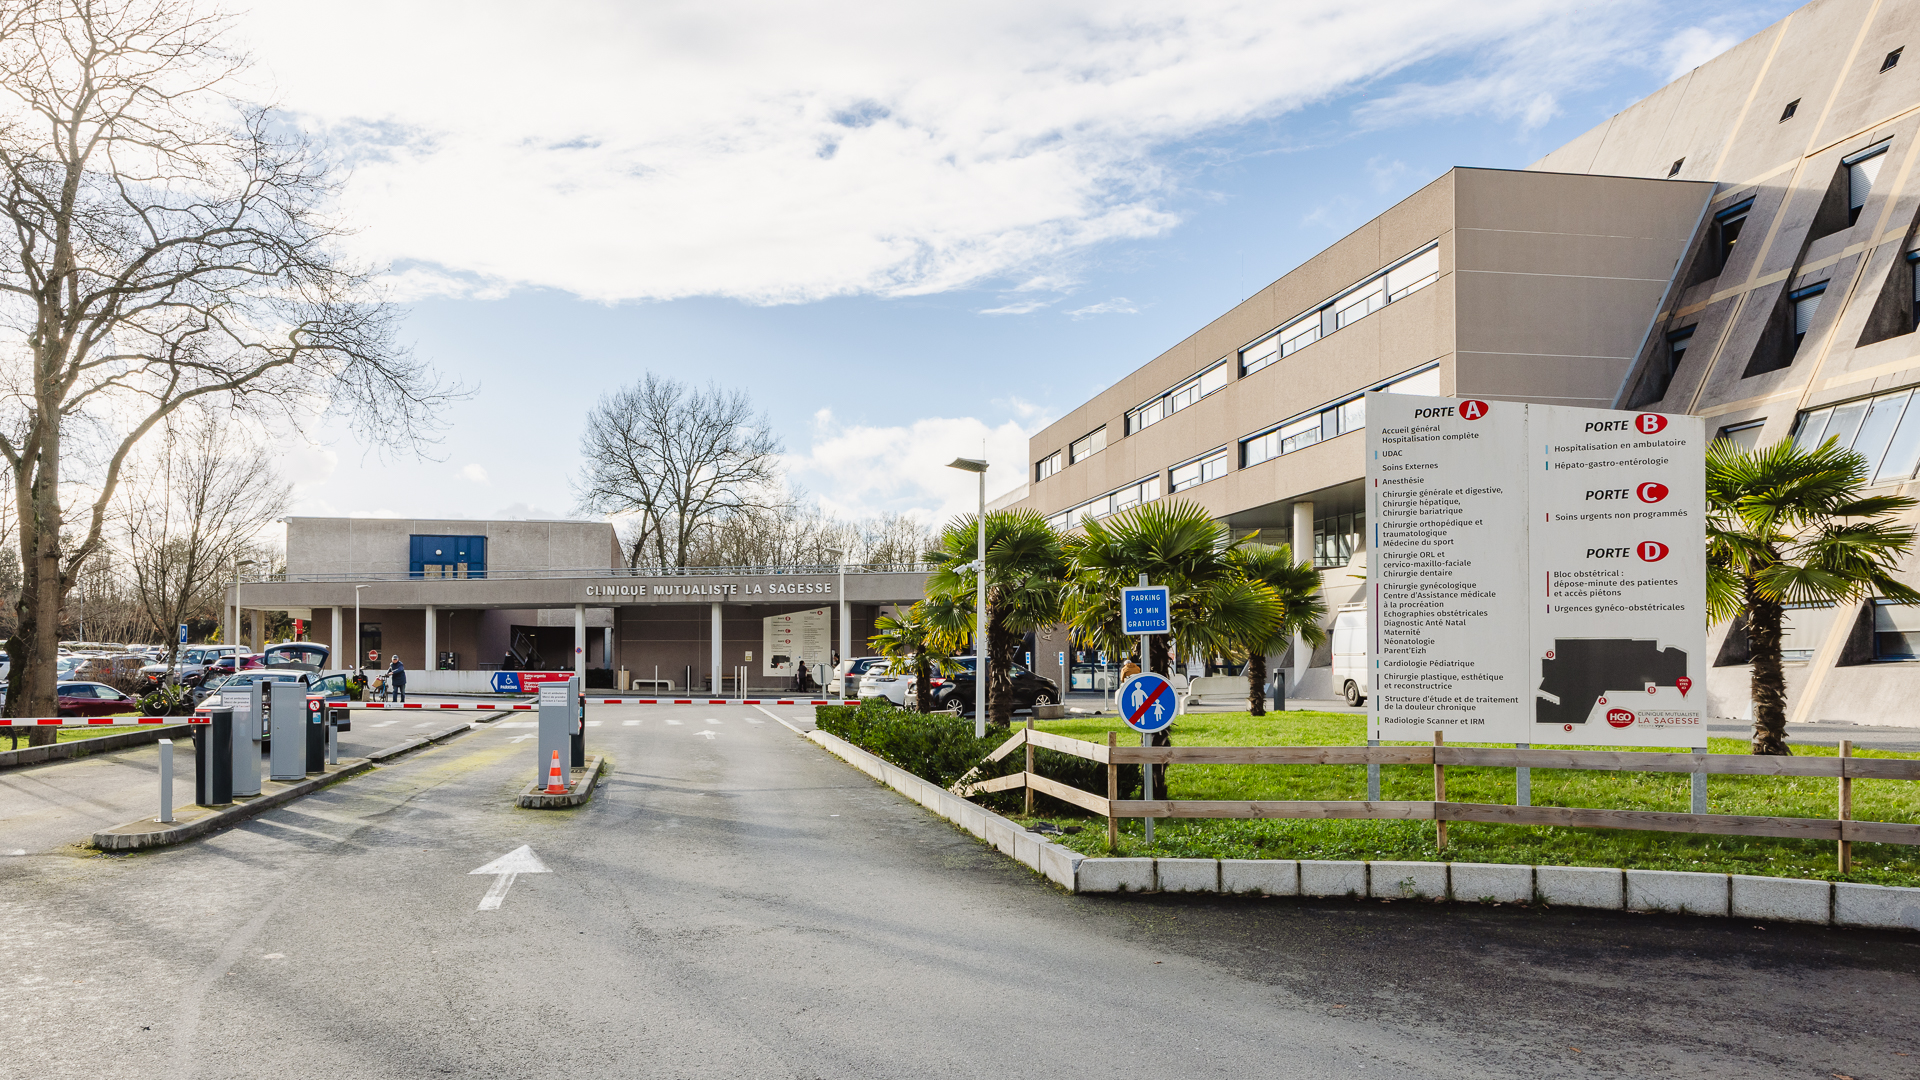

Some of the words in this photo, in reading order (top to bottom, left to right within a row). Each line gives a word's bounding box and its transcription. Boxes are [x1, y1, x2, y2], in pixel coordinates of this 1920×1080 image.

[1414, 406, 1455, 418] PORTE
[1465, 401, 1481, 418] A
[1585, 420, 1629, 433] PORTE
[1643, 414, 1659, 433] B
[1382, 427, 1409, 435] Accueil
[1411, 425, 1440, 434] général
[1382, 435, 1440, 444] Hospitalisation
[1442, 432, 1479, 441] complète
[1554, 443, 1618, 454] Hospitalisation
[1633, 439, 1686, 448] ambulatoire
[1554, 457, 1669, 470] Hépato-gastro-entérologie
[1382, 477, 1425, 485] Anesthésie
[1382, 490, 1417, 499] Chirurgie
[1419, 488, 1453, 498] générale
[1465, 487, 1503, 495] digestive,
[1585, 488, 1630, 501] PORTE
[1642, 484, 1657, 502] C
[1382, 499, 1417, 509] Chirurgie
[1419, 498, 1461, 507] hépatique,
[1382, 508, 1417, 518] Chirurgie
[1419, 507, 1463, 516] bariatrique
[1555, 513, 1578, 521] Soins
[1580, 512, 1612, 521] urgents
[1633, 509, 1687, 520] programmés
[1382, 520, 1418, 529] Chirurgie
[1419, 519, 1473, 528] orthopédique
[1383, 529, 1447, 539] traumatologique
[1383, 539, 1419, 547] Médecine
[1433, 539, 1454, 547] sport
[1383, 552, 1418, 560] Chirurgie
[1586, 547, 1630, 559] PORTE
[1644, 542, 1661, 560] D
[1383, 560, 1471, 568] cervico-maxillo-faciale
[1383, 570, 1418, 579] Chirurgie
[1420, 569, 1453, 577] dentaire
[1553, 570, 1571, 578] Bloc
[1383, 583, 1418, 591] Chirurgie
[1420, 582, 1477, 591] gynécologique
[1553, 580, 1618, 589] dépose-minute
[1637, 578, 1678, 587] patientes
[586, 585, 646, 596] CLINIQUE
[653, 584, 737, 595] MUTUALISTE
[746, 584, 762, 594] LA
[769, 582, 832, 594] SAGESSE
[1564, 589, 1587, 597] accès
[1589, 589, 1621, 598] piétons
[1399, 601, 1444, 609] procréation
[1554, 605, 1592, 614] Urgences
[1594, 604, 1685, 614] gynéco-obstétricales
[1384, 610, 1435, 619] Echographies
[1384, 620, 1423, 628] Diagnostic
[181, 628, 186, 640] P
[1384, 628, 1421, 636] Maternité
[1384, 638, 1435, 646] Néonatologie
[1384, 660, 1427, 668] Cardiologie
[1430, 660, 1475, 668] Pédiatrique
[1384, 673, 1419, 682] Chirurgie
[1421, 673, 1459, 682] plastique,
[1461, 673, 1503, 682] esthétique
[1394, 682, 1452, 690] reconstructrice
[1437, 704, 1476, 712] chronique
[1384, 717, 1424, 725] Radiologie
[1610, 713, 1631, 721] HGO
